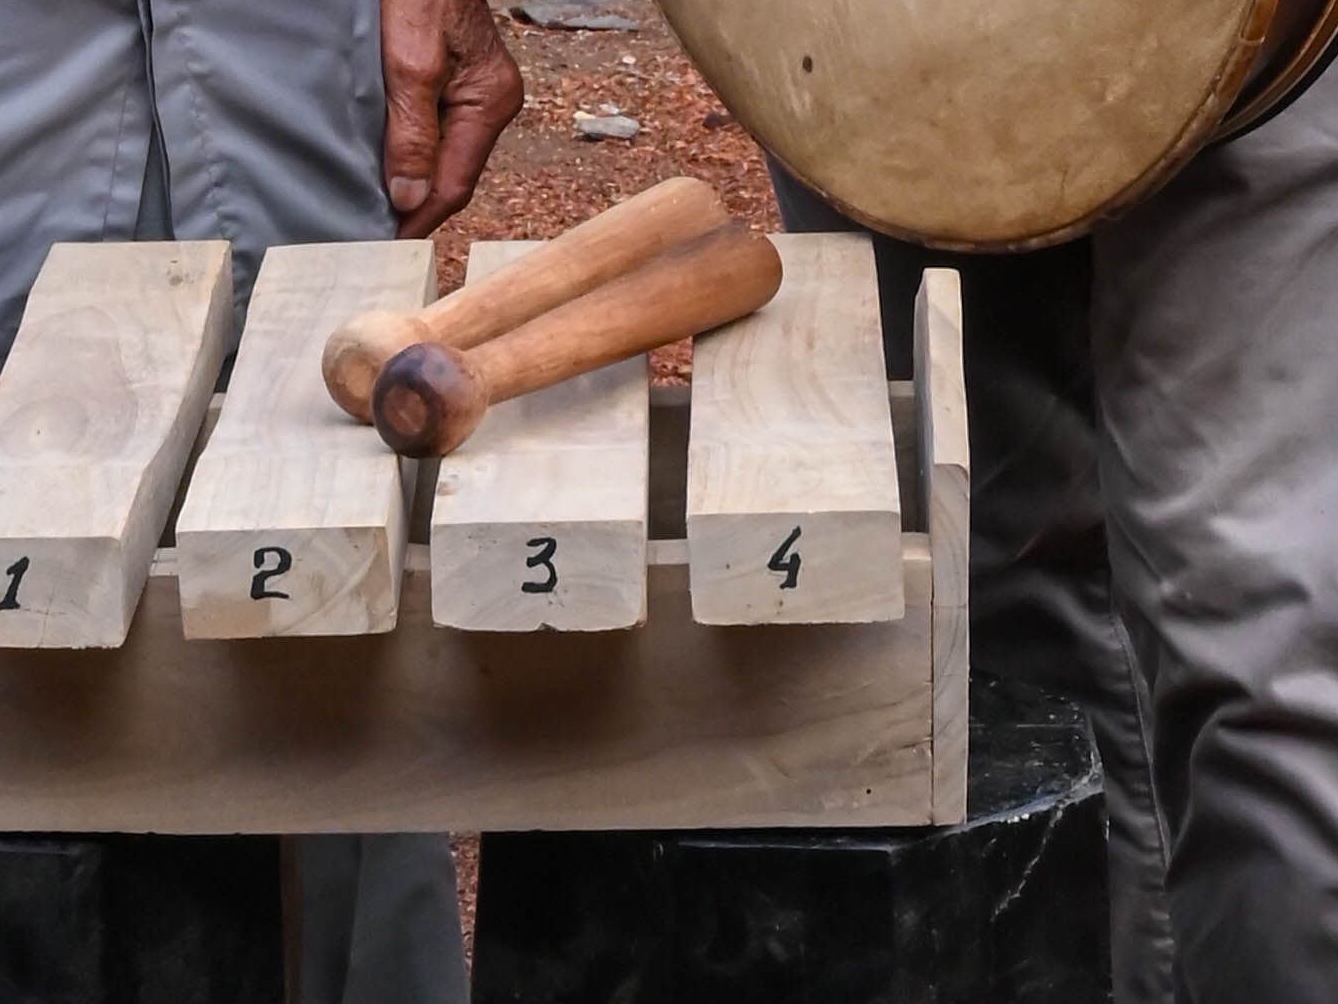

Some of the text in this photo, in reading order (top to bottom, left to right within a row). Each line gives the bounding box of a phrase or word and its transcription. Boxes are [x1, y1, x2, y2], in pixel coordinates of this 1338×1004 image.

[250, 546, 293, 601] 2
[521, 536, 558, 594] 3
[767, 526, 803, 590] 4
